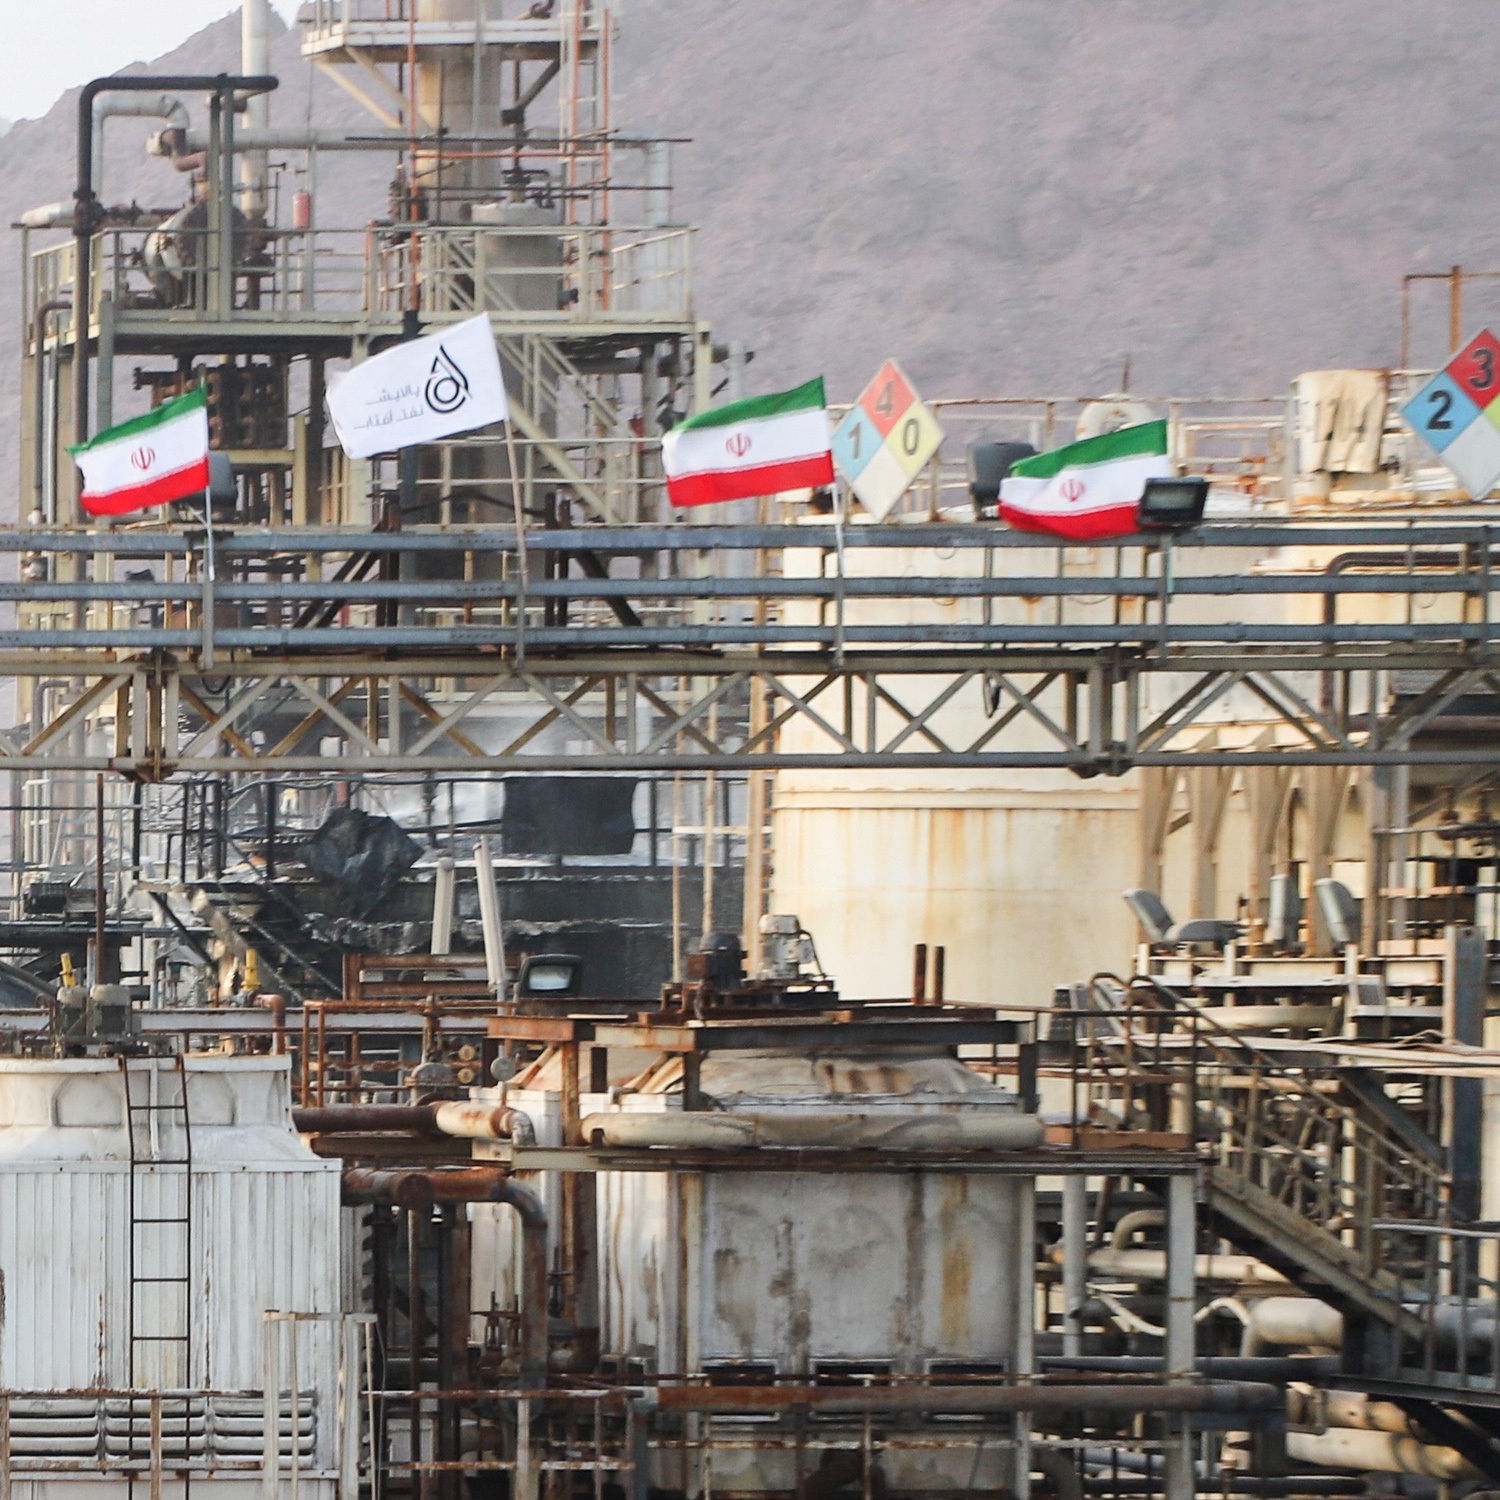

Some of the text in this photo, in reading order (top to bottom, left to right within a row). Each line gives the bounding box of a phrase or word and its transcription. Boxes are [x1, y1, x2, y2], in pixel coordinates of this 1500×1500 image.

[1469, 348, 1495, 389] 3
[875, 380, 896, 417] 4
[1426, 389, 1454, 430] 2
[848, 422, 862, 459] 1
[903, 418, 919, 456] 0
